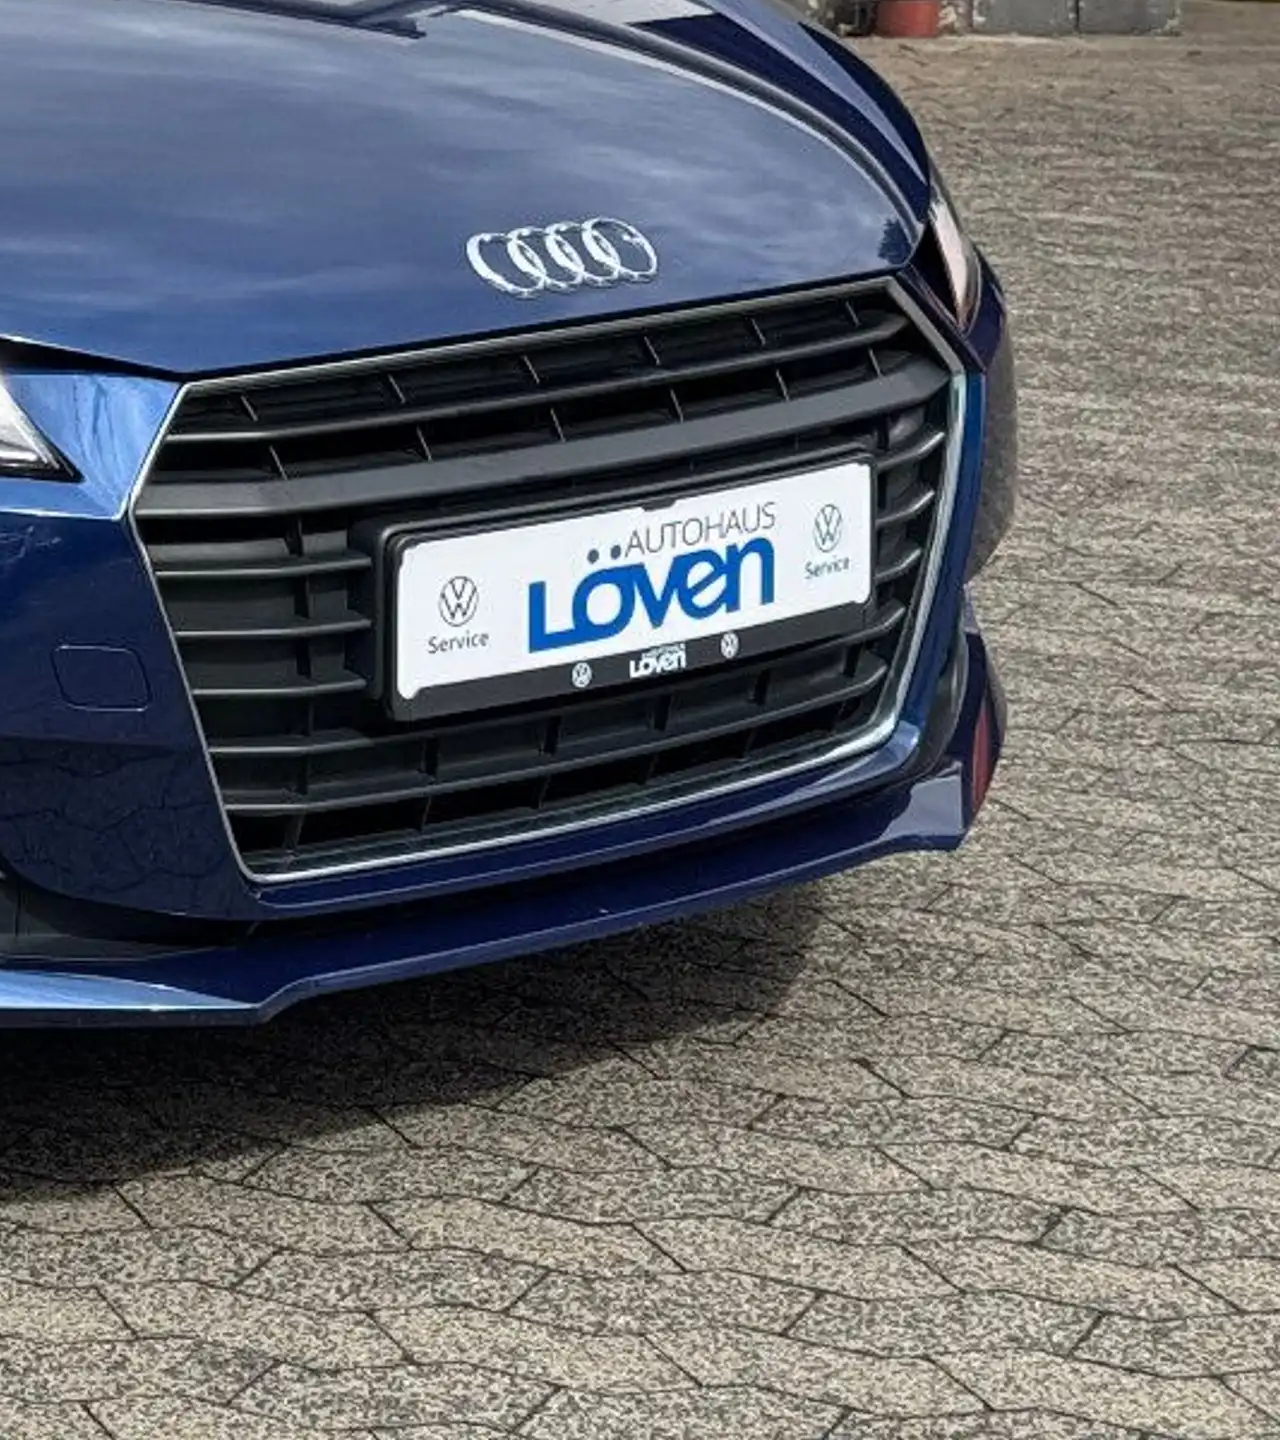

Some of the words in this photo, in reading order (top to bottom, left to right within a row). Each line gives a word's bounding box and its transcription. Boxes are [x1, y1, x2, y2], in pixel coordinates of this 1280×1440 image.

[624, 500, 777, 560] AUTOHAUS
[804, 556, 851, 580] Service
[527, 536, 776, 653] Löven
[427, 629, 490, 655] Service
